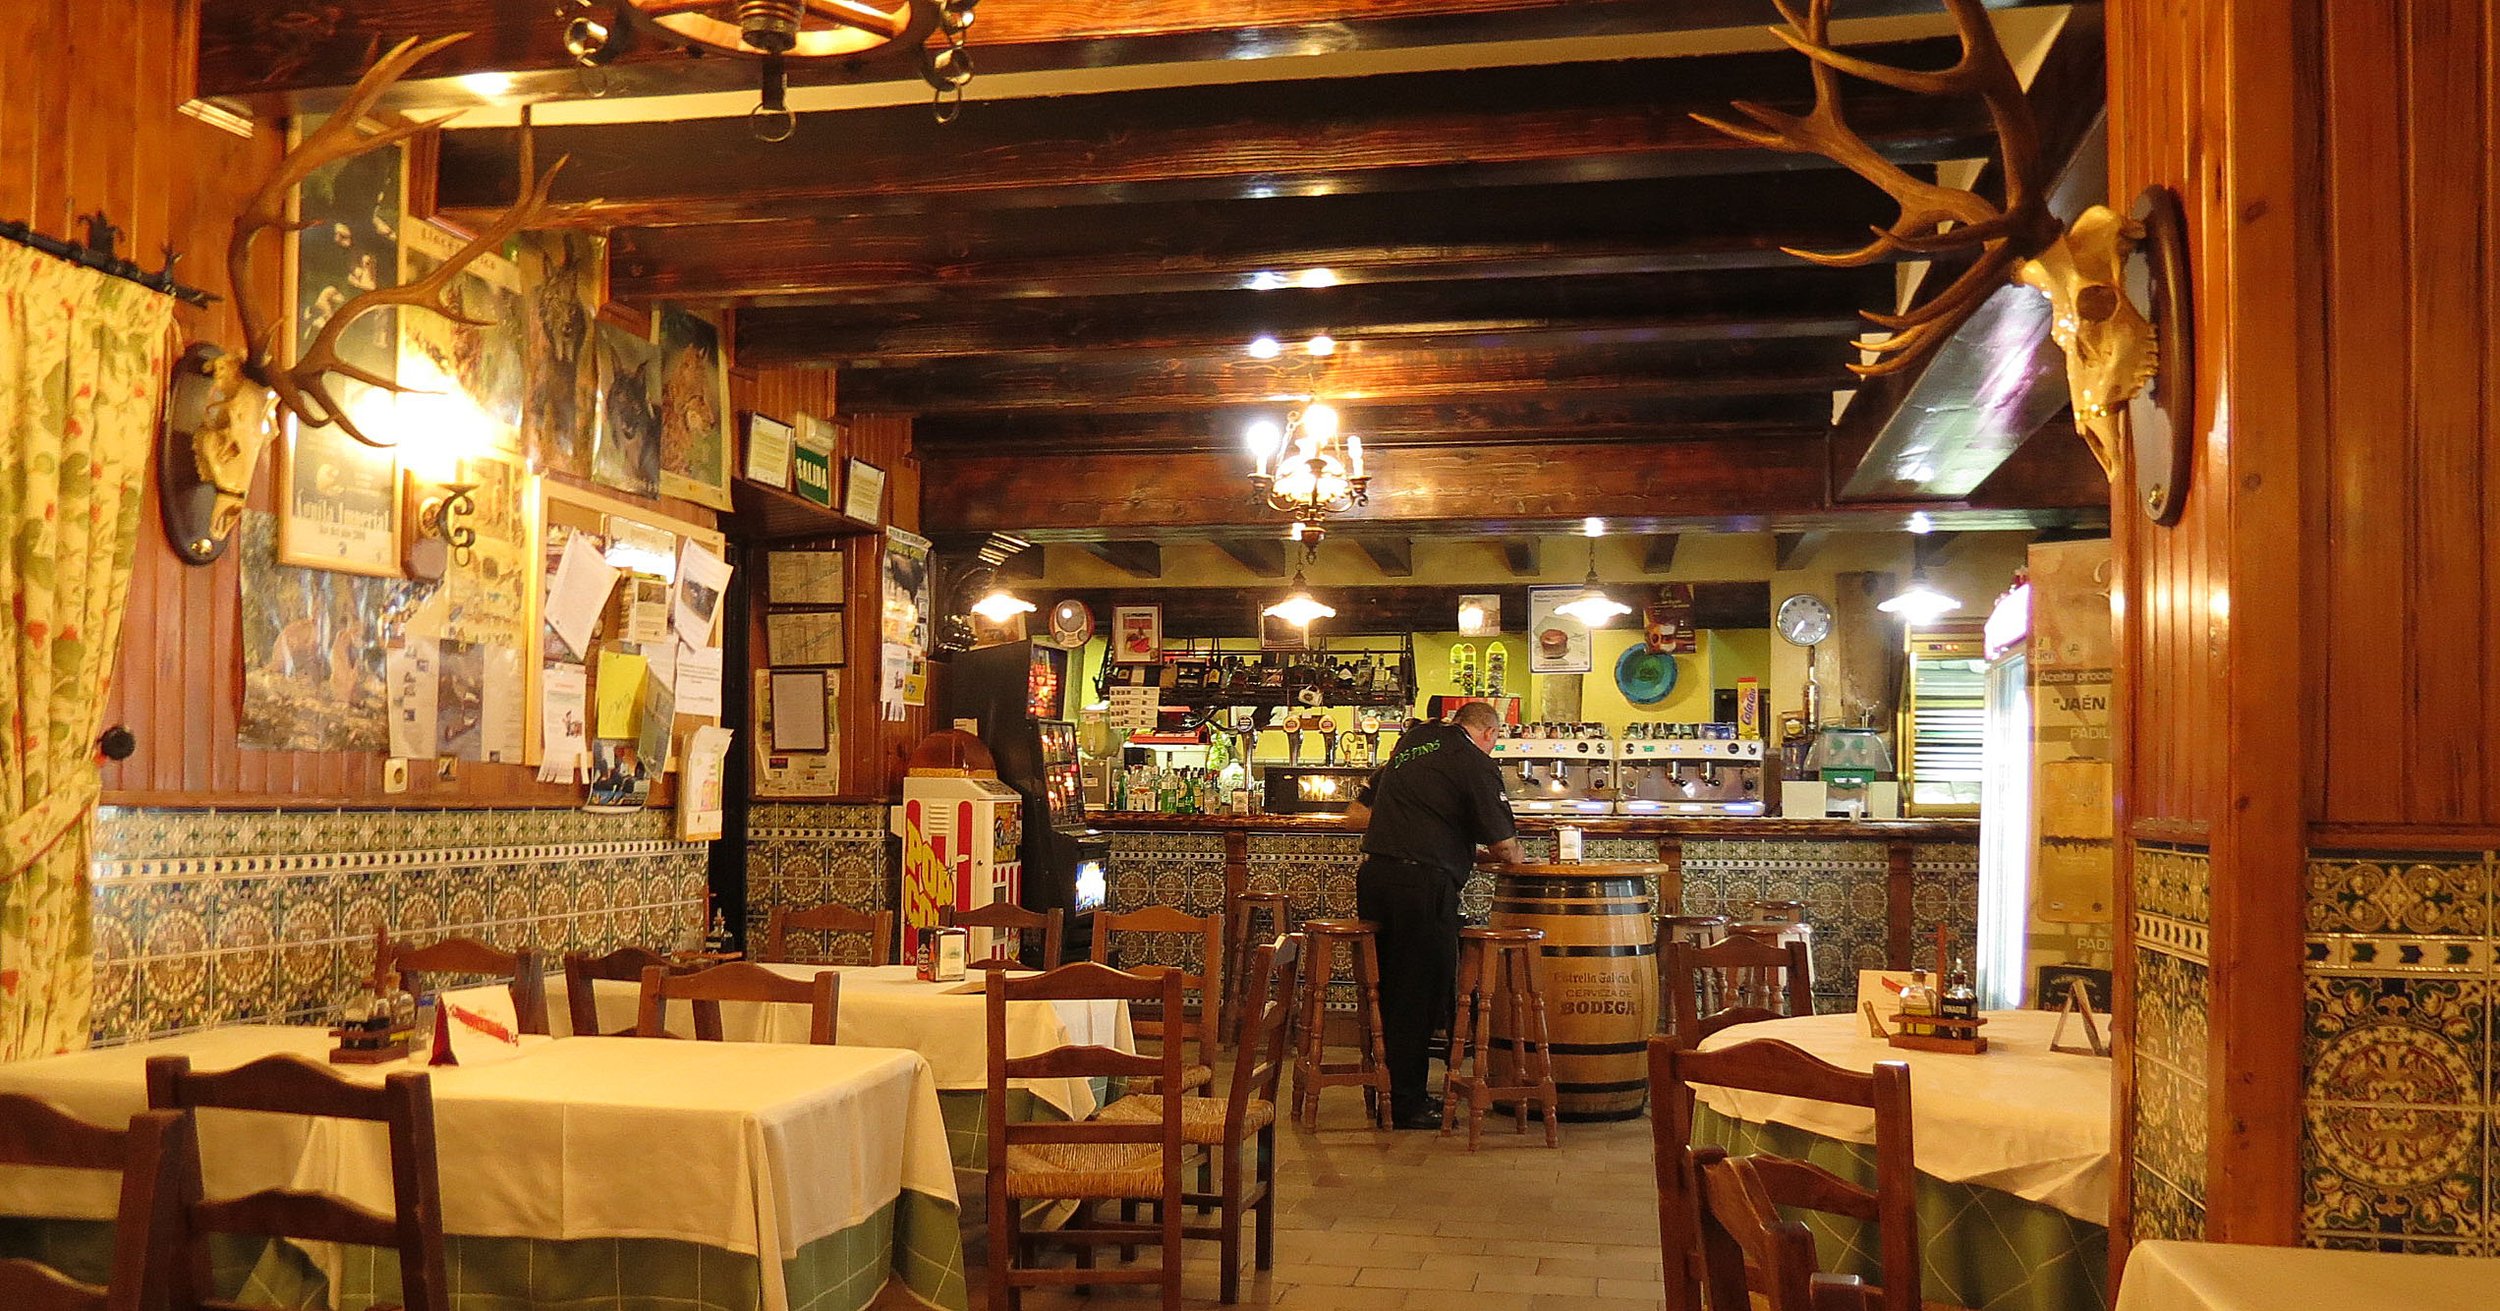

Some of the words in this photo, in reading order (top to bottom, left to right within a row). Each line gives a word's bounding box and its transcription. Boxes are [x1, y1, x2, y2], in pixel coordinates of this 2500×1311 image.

[796, 458, 827, 490] SALIDA
[1565, 989, 1617, 998] CERVEZA
[1560, 1001, 1636, 1016] BODEGA
